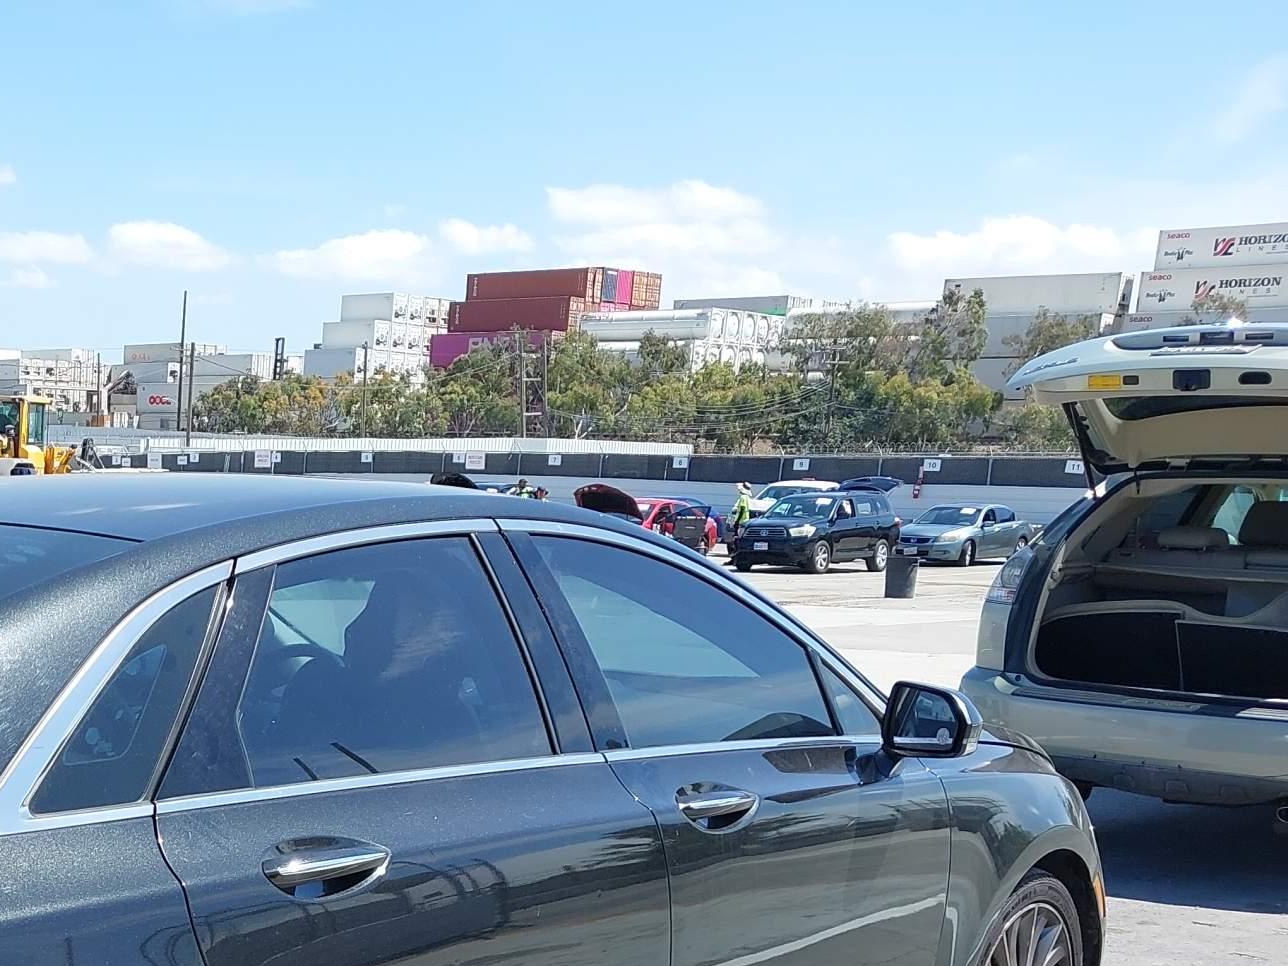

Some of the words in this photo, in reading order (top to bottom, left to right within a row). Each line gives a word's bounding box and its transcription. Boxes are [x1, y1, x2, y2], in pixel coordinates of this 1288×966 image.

[1167, 232, 1191, 240] seaco
[1218, 276, 1282, 289] HORIZON
[927, 461, 937, 469] 10
